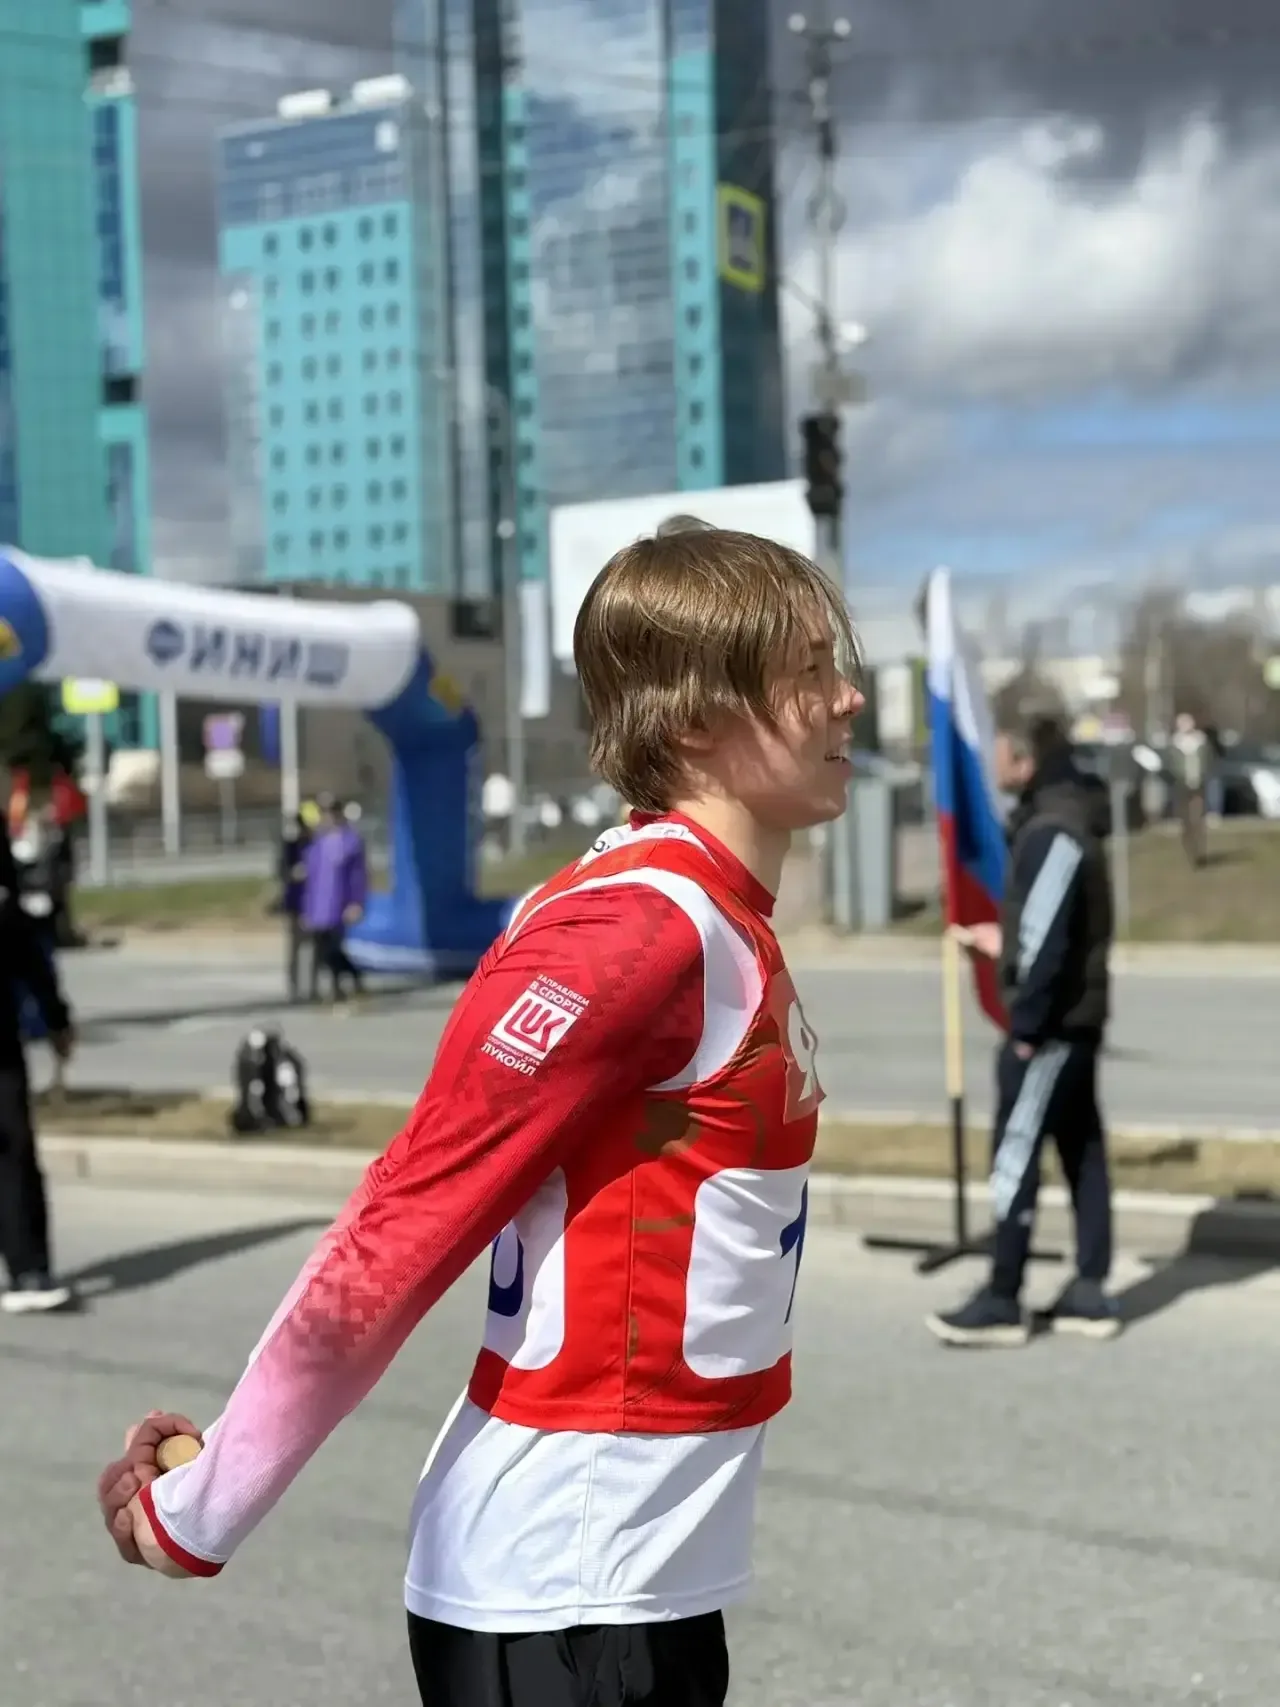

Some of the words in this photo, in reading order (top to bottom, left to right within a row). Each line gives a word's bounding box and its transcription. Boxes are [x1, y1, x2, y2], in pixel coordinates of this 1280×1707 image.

[529, 980, 539, 991] В
[538, 986, 585, 1016] СПОРТЕ
[480, 1042, 537, 1077] ЛУКОЙЛ
